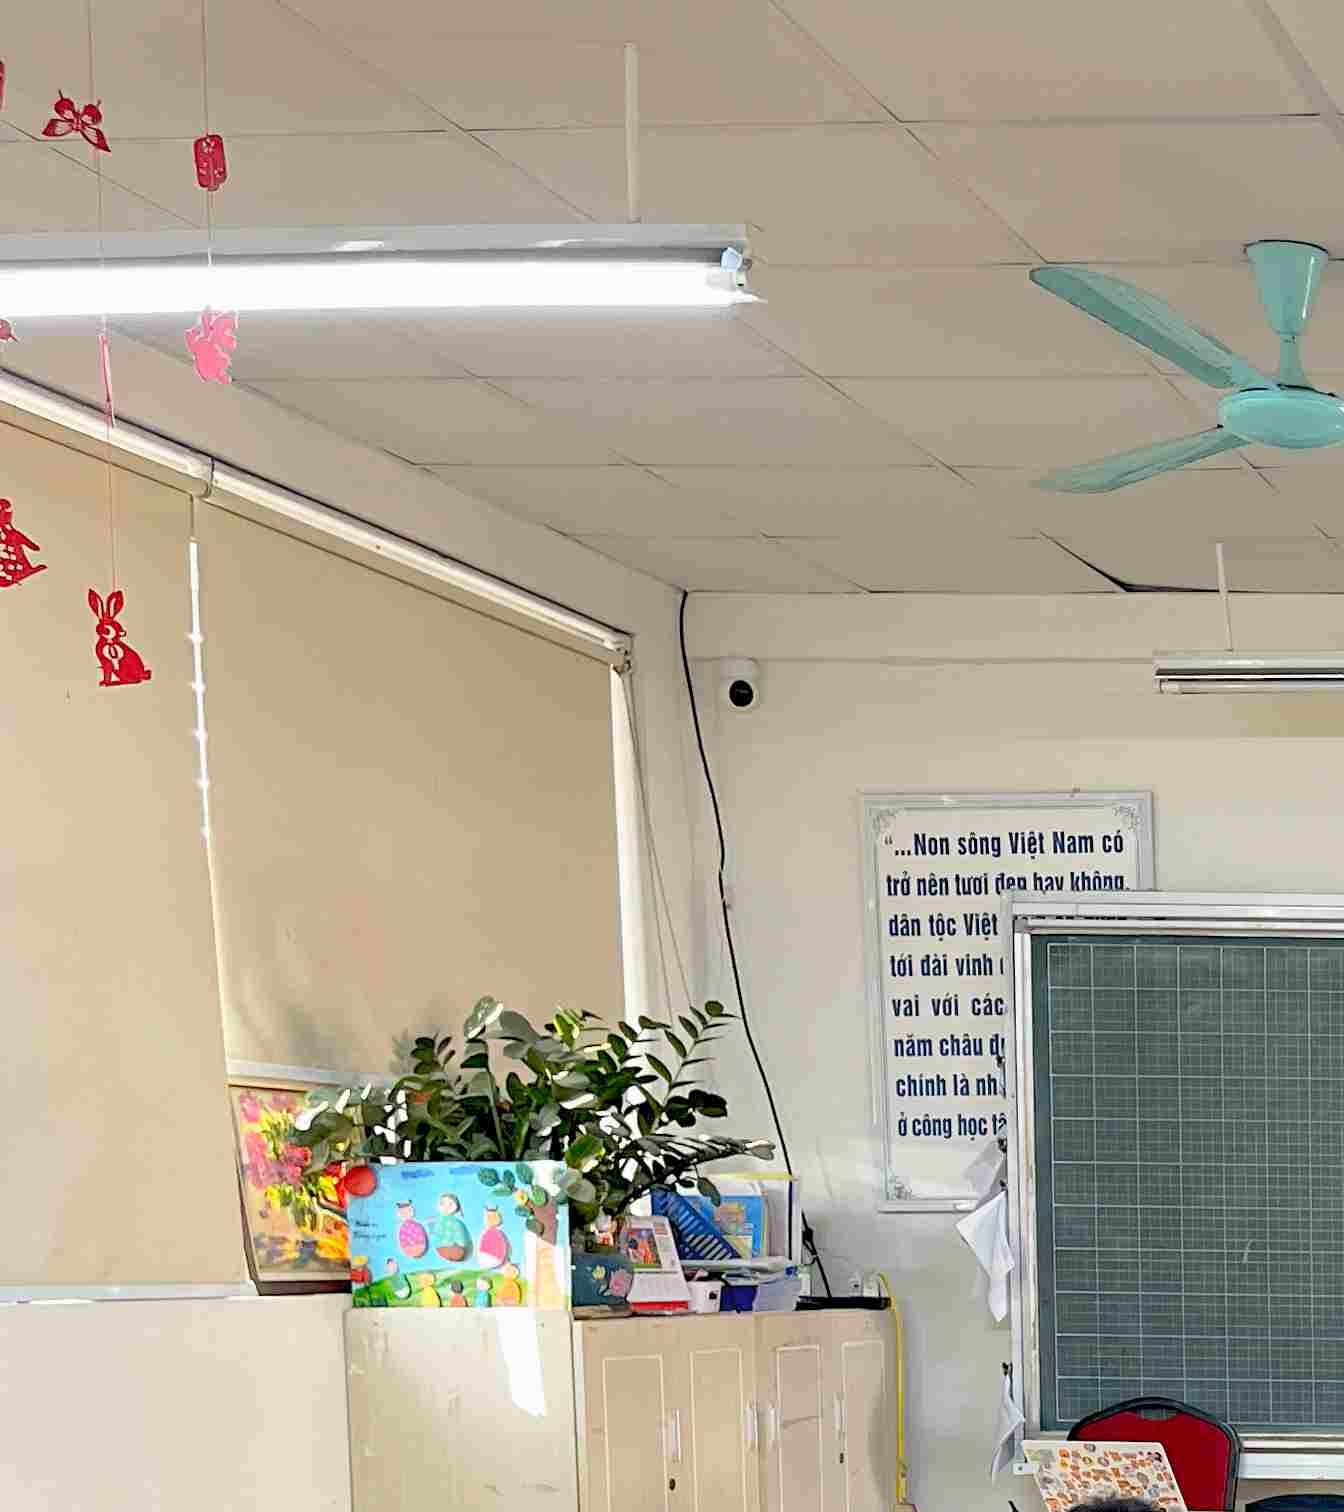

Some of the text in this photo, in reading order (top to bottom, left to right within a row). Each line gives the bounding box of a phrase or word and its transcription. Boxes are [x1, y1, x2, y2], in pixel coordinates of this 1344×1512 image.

[957, 832, 1001, 858] sông
[1008, 831, 1045, 859] Việt
[1052, 831, 1094, 854] Nam
[1101, 830, 1124, 853] có
[886, 871, 911, 896] trở
[916, 872, 949, 896] nên
[955, 872, 988, 896] tươi
[888, 912, 999, 941] dân tộc Việt
[890, 954, 913, 977] tới
[920, 954, 948, 976] đài
[955, 953, 993, 976] vinh
[892, 992, 1004, 1017] vai với các
[894, 1033, 933, 1057] năm
[939, 1033, 983, 1057] châu
[896, 1073, 947, 1097] chính
[953, 1073, 970, 1096] là
[912, 1113, 952, 1139] công
[957, 1113, 988, 1141] học
